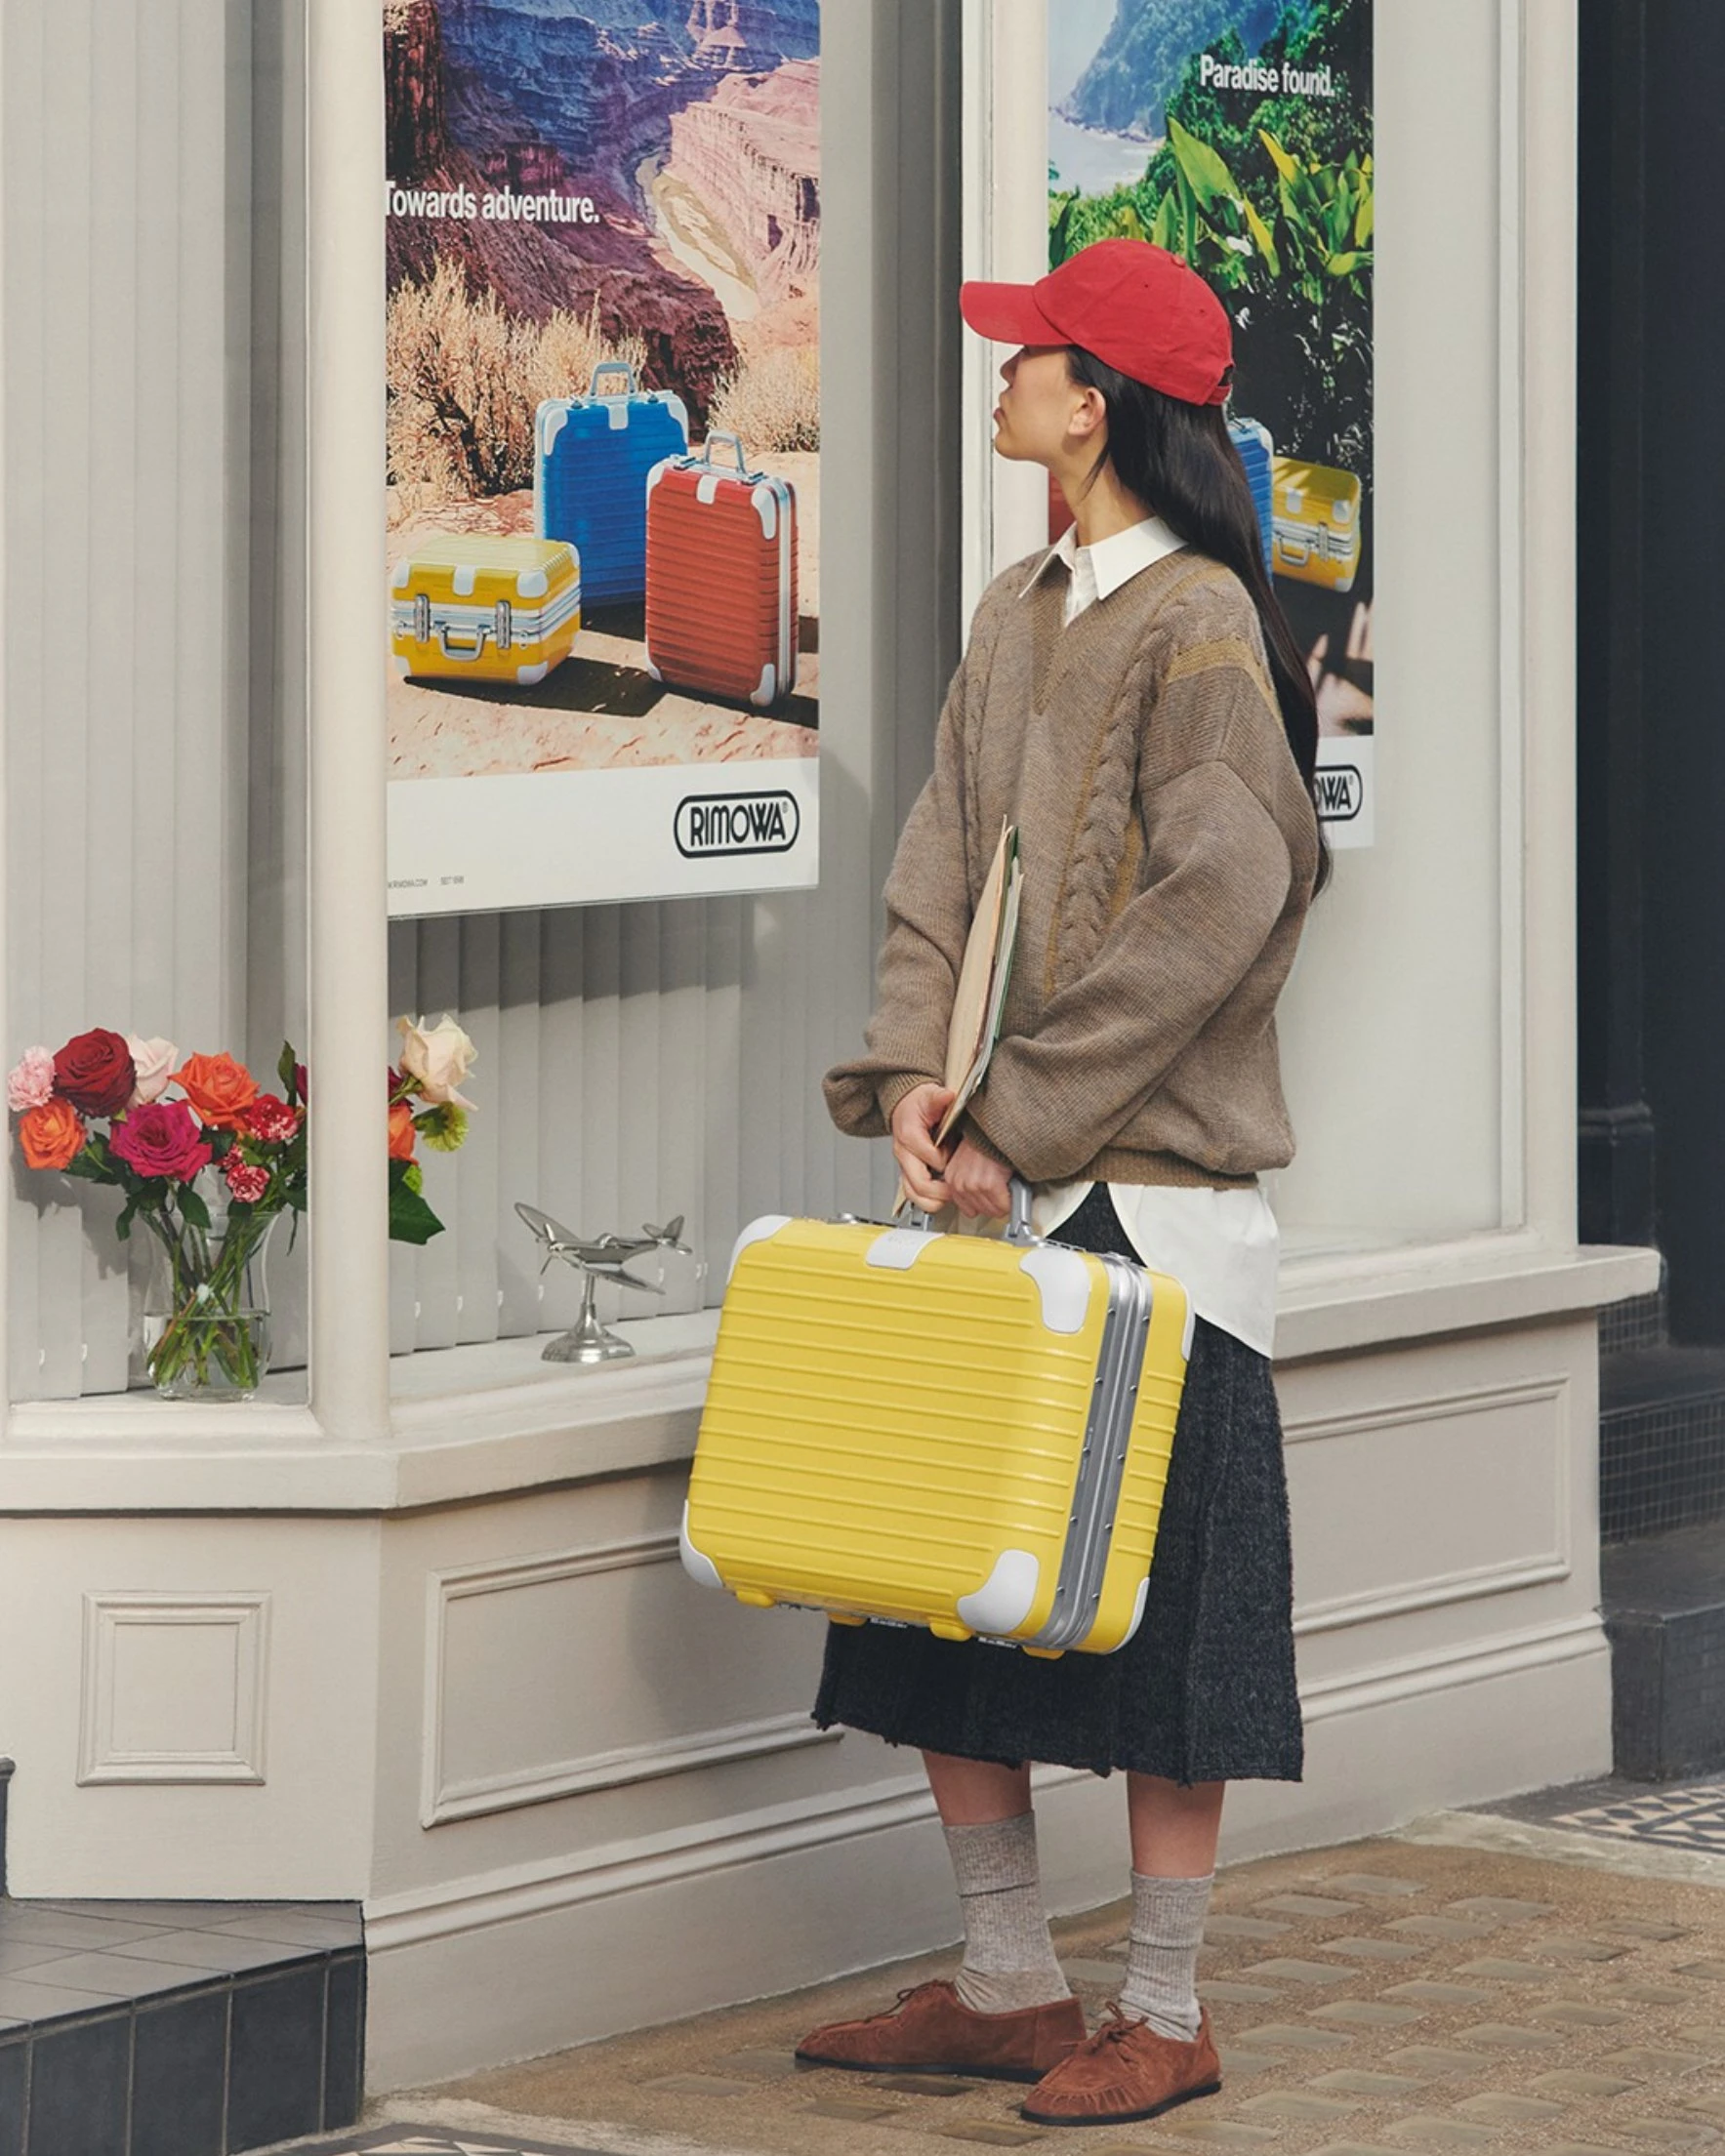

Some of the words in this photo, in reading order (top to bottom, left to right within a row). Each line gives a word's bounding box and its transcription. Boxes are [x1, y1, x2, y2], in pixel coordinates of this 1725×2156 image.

[1200, 54, 1279, 93] Paradise
[1281, 61, 1335, 97] found.
[385, 181, 476, 221] Towards
[481, 184, 600, 224] adventure.
[690, 802, 787, 847] RIMOWA
